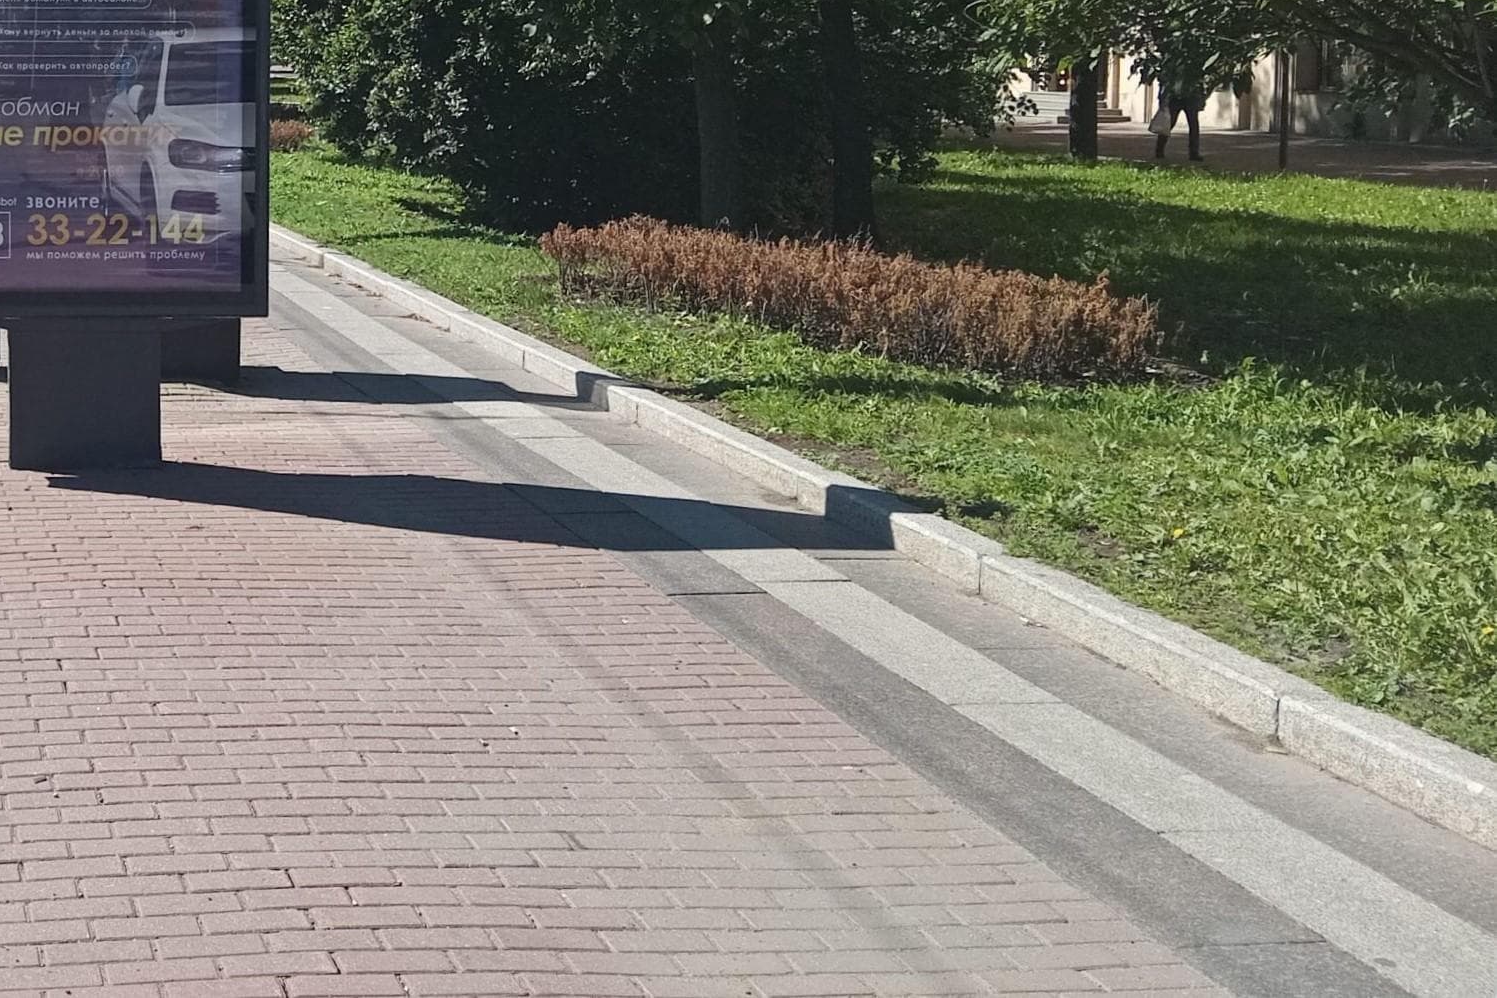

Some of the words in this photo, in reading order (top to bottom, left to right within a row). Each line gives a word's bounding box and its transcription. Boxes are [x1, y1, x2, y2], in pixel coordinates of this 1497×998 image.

[1, 96, 81, 117] обман
[25, 196, 100, 209] звоните
[26, 213, 206, 245] 33-22-144
[26, 251, 44, 260] мы
[46, 251, 101, 260] поможем
[104, 250, 147, 262] решить
[150, 249, 206, 262] проблему
